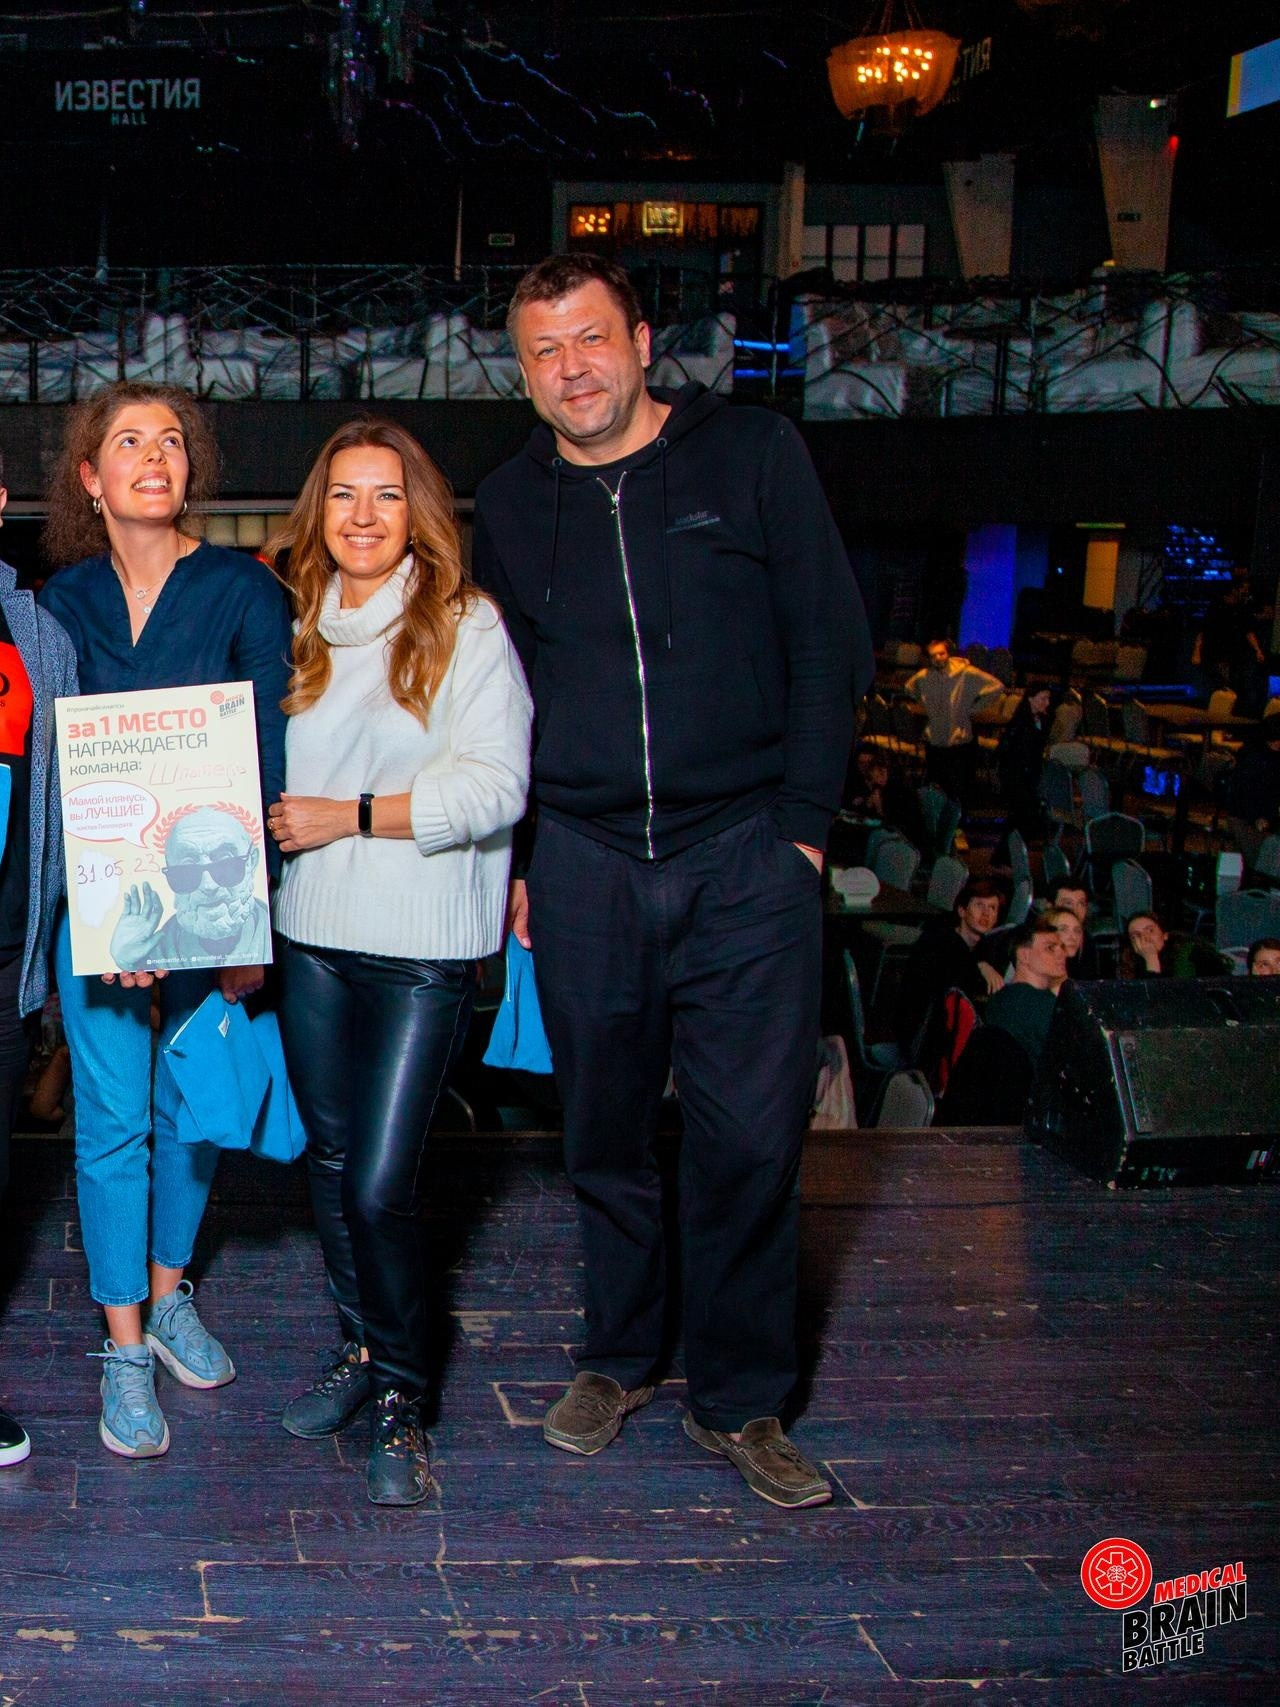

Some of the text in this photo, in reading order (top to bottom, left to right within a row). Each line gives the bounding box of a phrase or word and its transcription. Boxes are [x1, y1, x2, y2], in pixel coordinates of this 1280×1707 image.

[54, 78, 201, 112] ИЗВЕСТИЯ
[111, 112, 148, 126] HALL
[219, 697, 245, 713] BRAIN
[68, 722, 96, 739] за
[99, 715, 111, 736] 1
[118, 707, 207, 735] МЕСТО
[68, 732, 208, 759] НАГРАЖДАЕТСЯ
[69, 760, 142, 776] команда:
[68, 795, 104, 806] Мамой
[85, 804, 144, 819] ЛУЧШИЕ!
